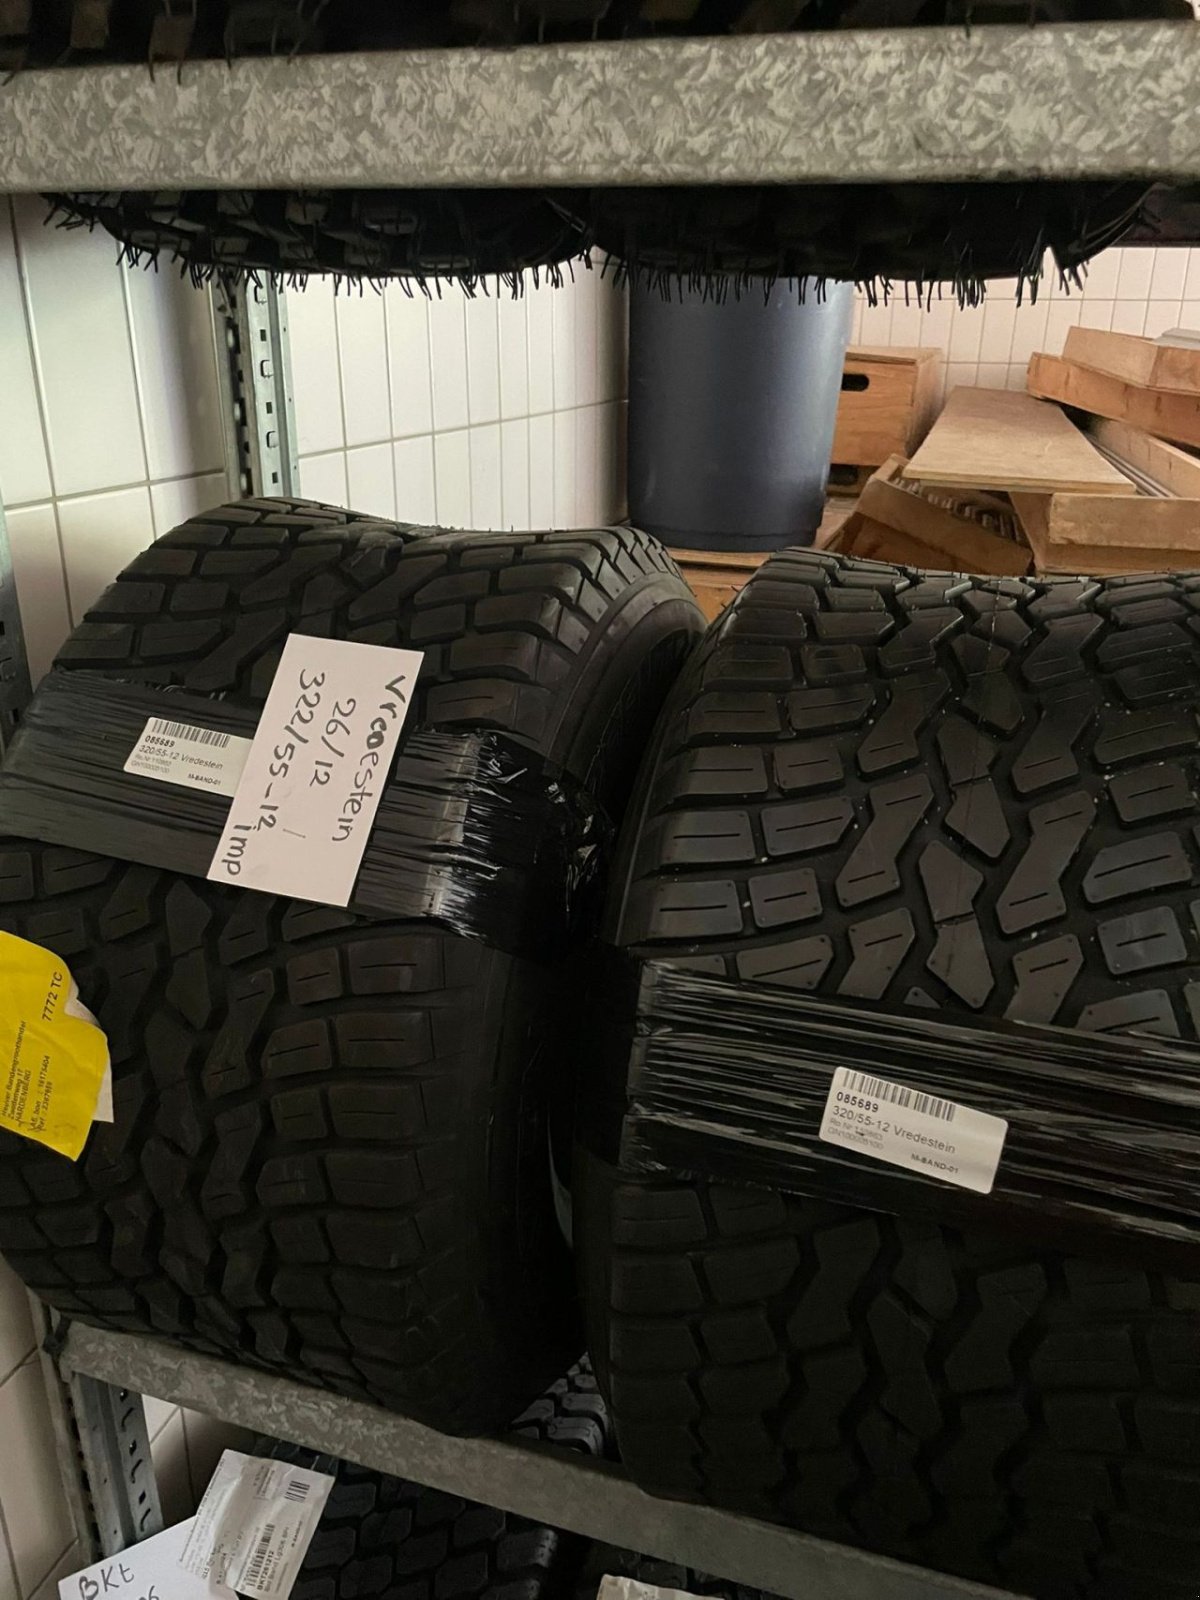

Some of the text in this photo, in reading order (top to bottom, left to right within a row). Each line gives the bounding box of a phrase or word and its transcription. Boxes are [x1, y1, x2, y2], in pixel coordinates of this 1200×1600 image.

[309, 697, 356, 787] 26/12
[181, 753, 224, 770] Vredestein
[42, 971, 63, 1022] 7772 TC
[836, 1091, 879, 1113] 085689
[832, 1105, 890, 1132] 320/55-12
[894, 1125, 956, 1154] Vredestein
[911, 1153, 960, 1174] M-BAND-01
